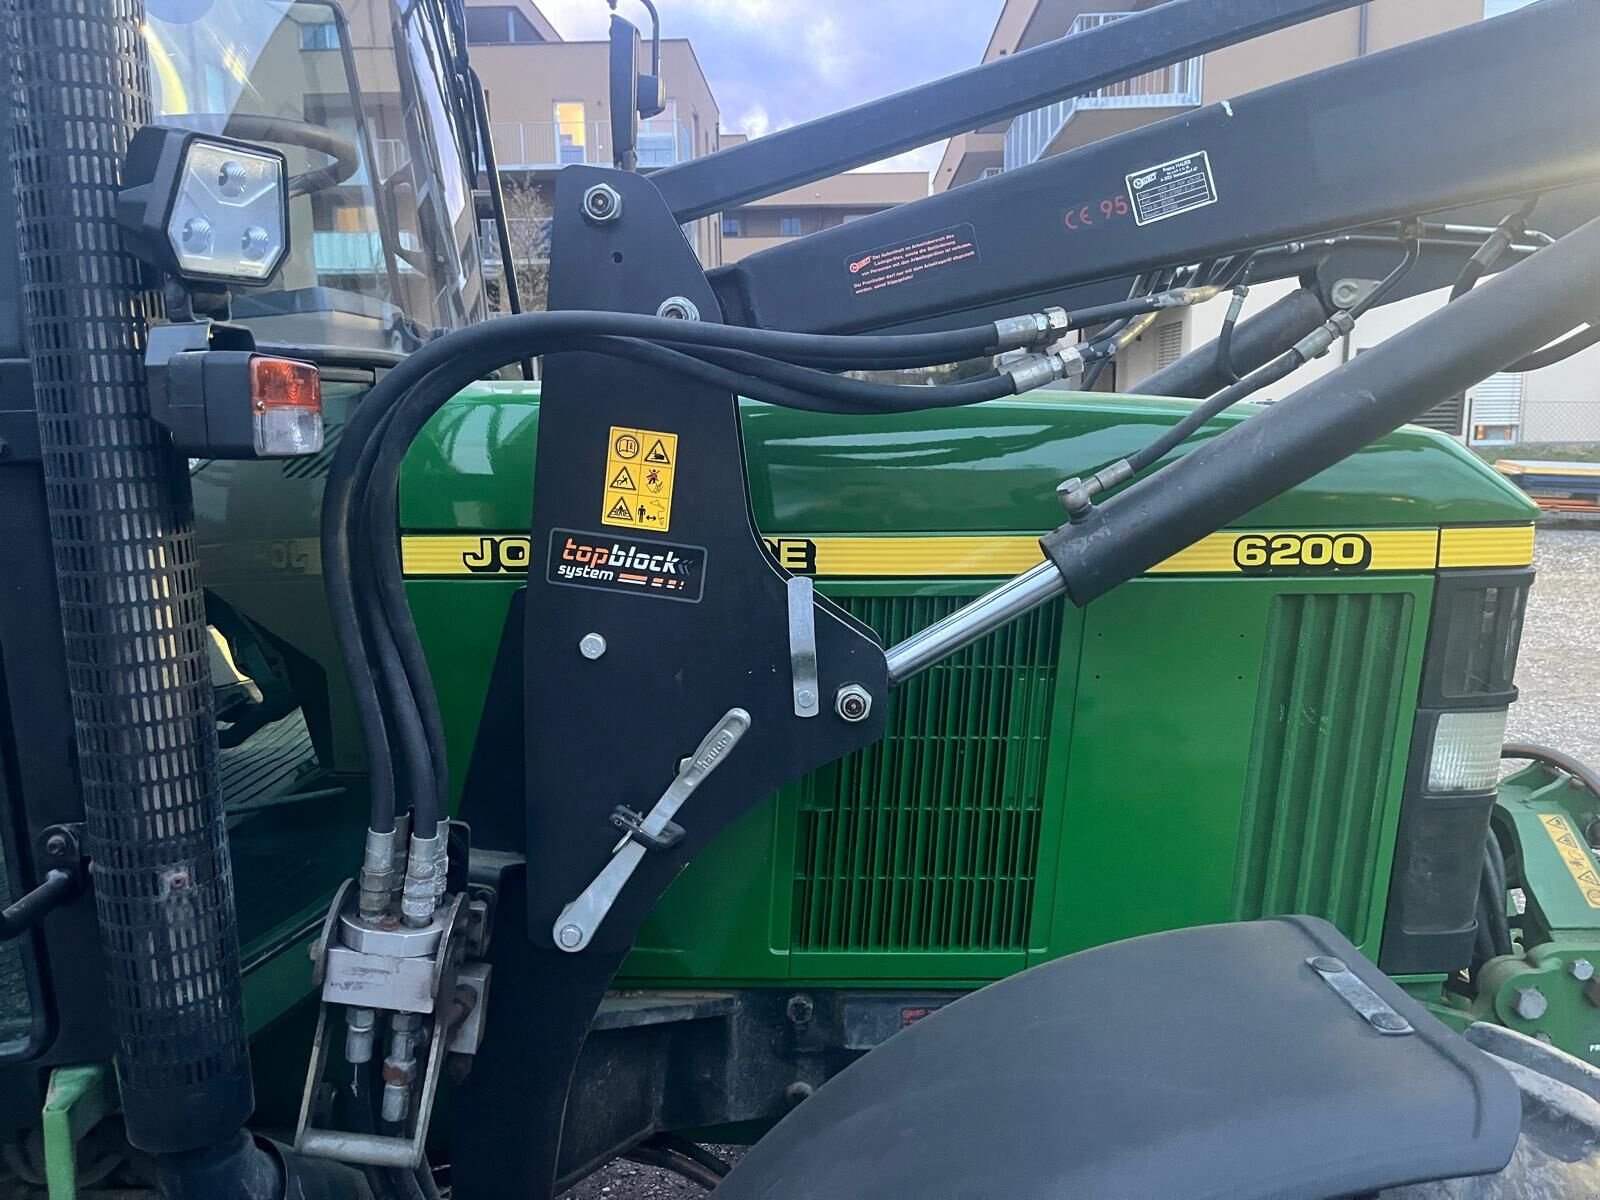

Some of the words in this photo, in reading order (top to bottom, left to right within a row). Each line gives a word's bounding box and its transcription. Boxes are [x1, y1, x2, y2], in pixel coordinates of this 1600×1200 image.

[1065, 206, 1093, 229] CE
[1100, 195, 1128, 219] 95
[562, 538, 680, 575] topblock
[1234, 534, 1371, 570] 6200
[557, 564, 614, 581] system
